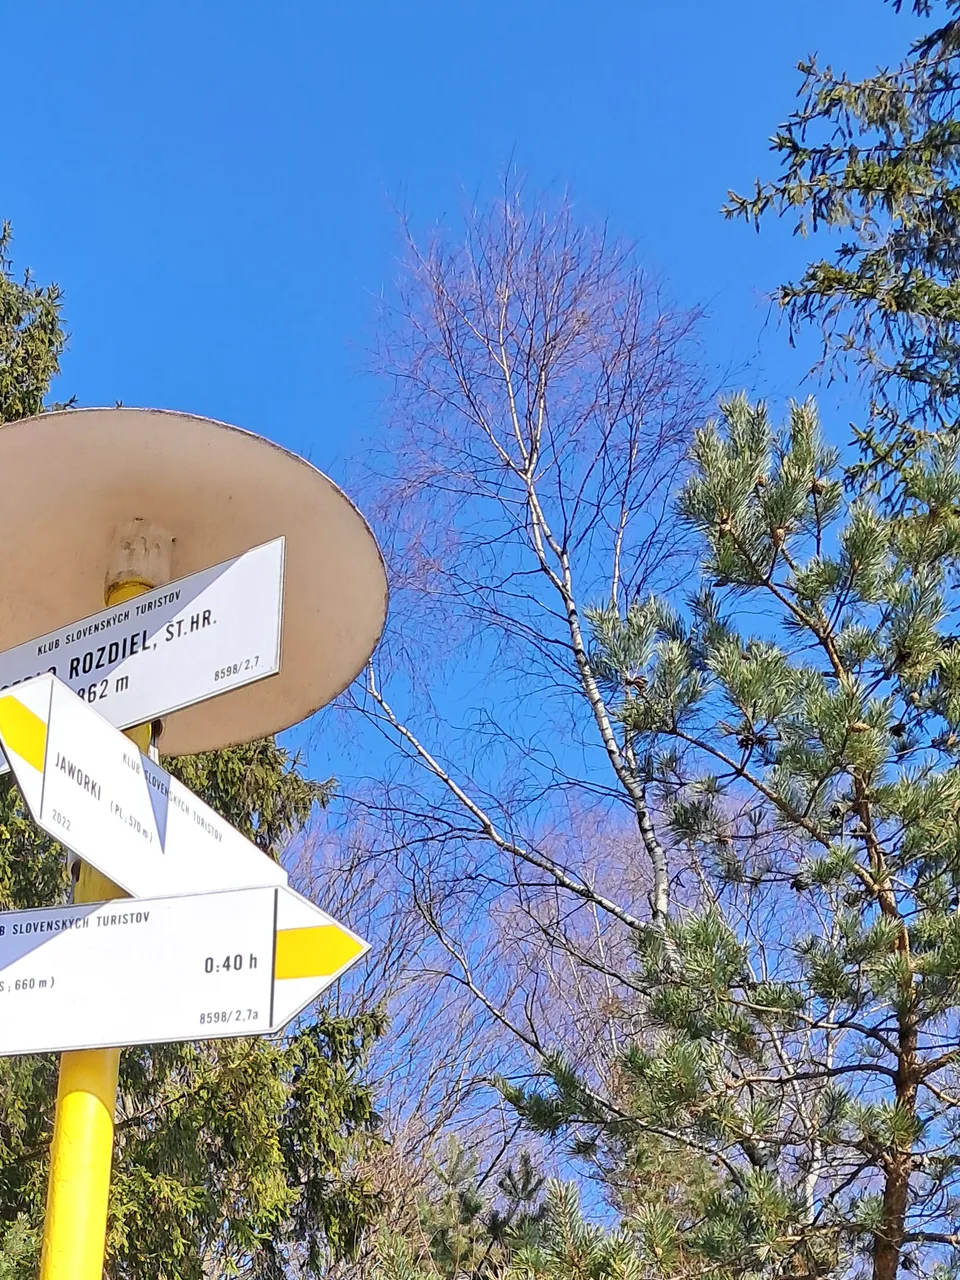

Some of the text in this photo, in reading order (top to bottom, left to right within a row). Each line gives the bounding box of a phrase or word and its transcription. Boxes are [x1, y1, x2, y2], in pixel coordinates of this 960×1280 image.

[37, 589, 182, 656] KLUB SLOVENSKÝCH TURISTOV
[68, 629, 158, 680] ROZDIEL,
[115, 675, 130, 693] m
[55, 752, 101, 801] JAWORKI
[129, 815, 141, 833] 570
[122, 752, 141, 775] KLUB
[193, 810, 223, 843] TURISTOV
[52, 808, 72, 832] 2022
[12, 916, 90, 935] SLOVENSKÝCH
[96, 911, 150, 928] TURISTOV
[204, 953, 258, 974] 0:40 h
[14, 978, 36, 991] 660
